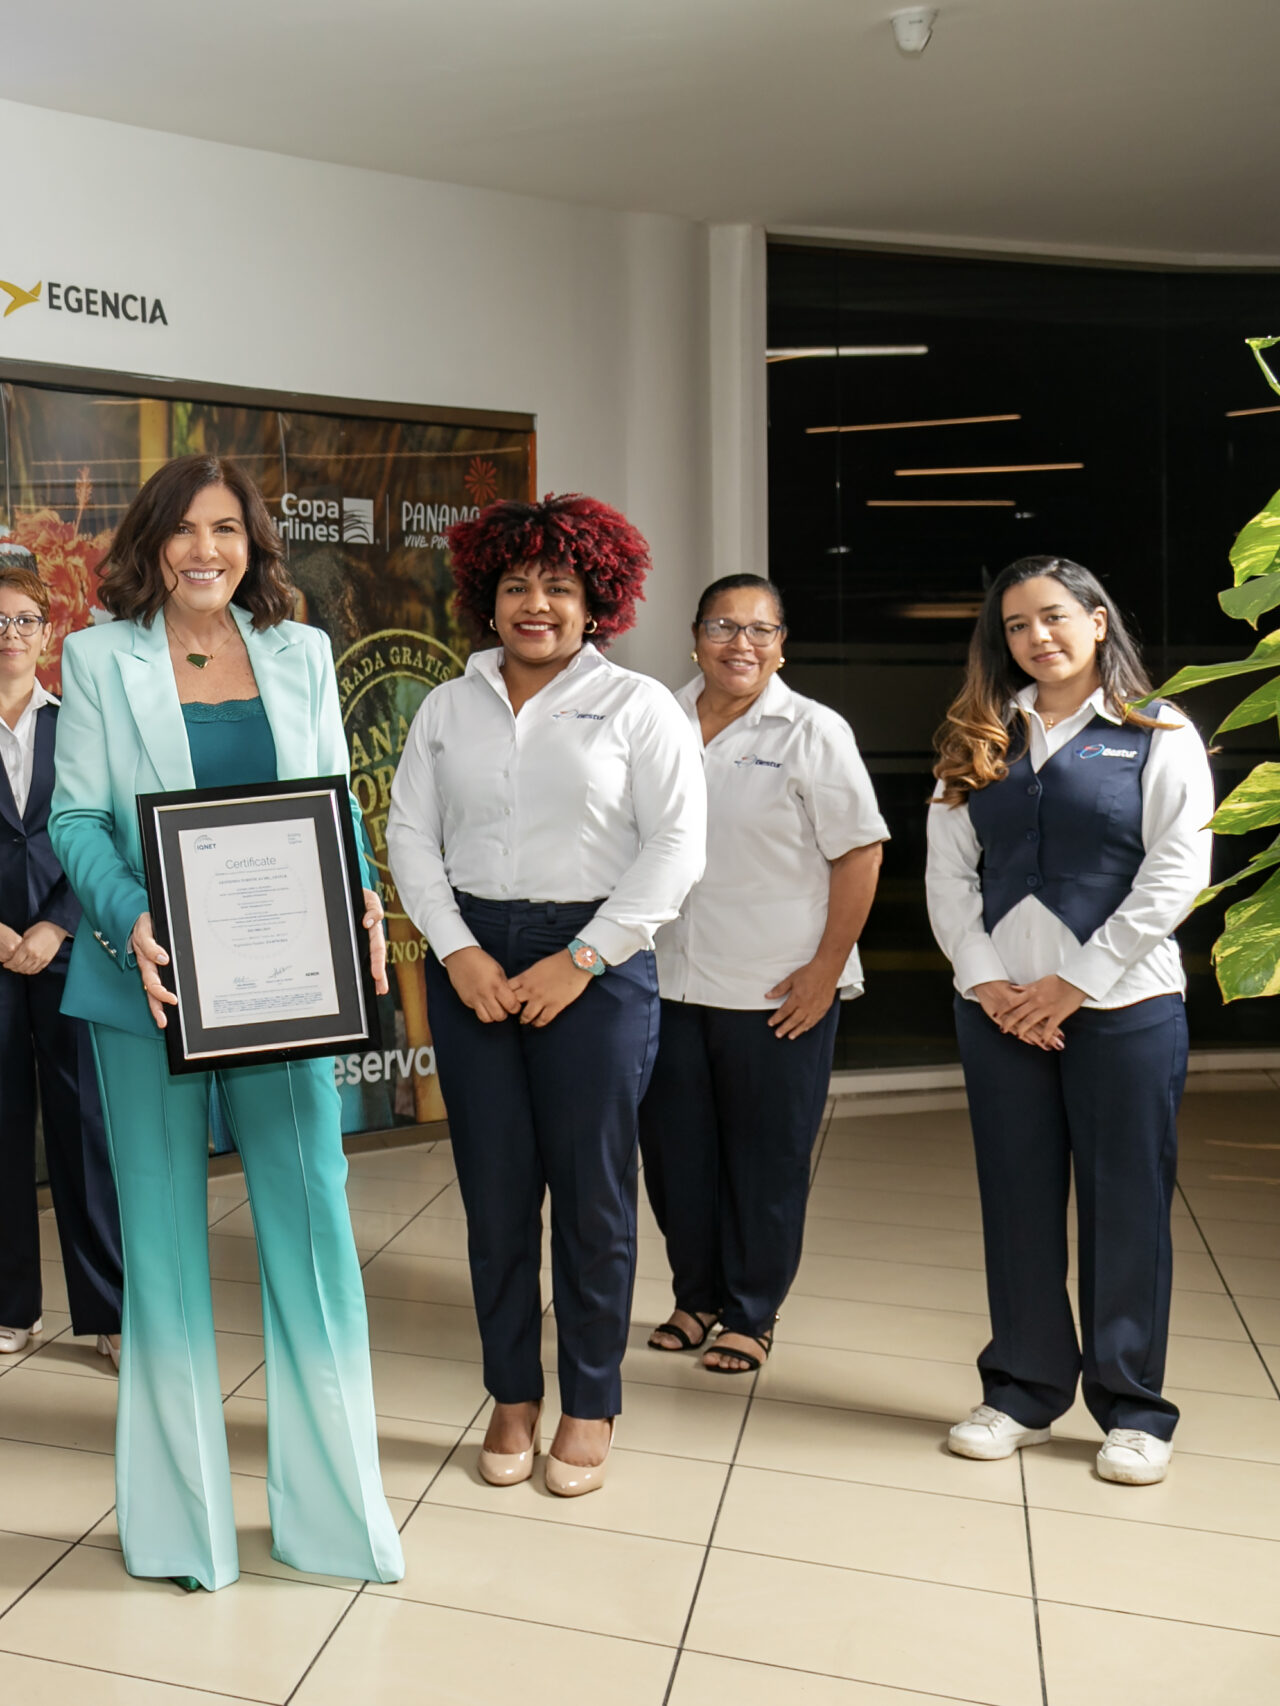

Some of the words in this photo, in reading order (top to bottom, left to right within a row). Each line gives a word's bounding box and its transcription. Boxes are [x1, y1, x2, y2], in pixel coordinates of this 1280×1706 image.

[48, 282, 168, 326] EGENCIA
[281, 493, 339, 521] Copa
[272, 516, 339, 542] irlines
[404, 534, 428, 548] VIVE
[390, 646, 451, 682] GRATIS
[225, 857, 277, 870] Certificate
[334, 1044, 437, 1087] eserva
